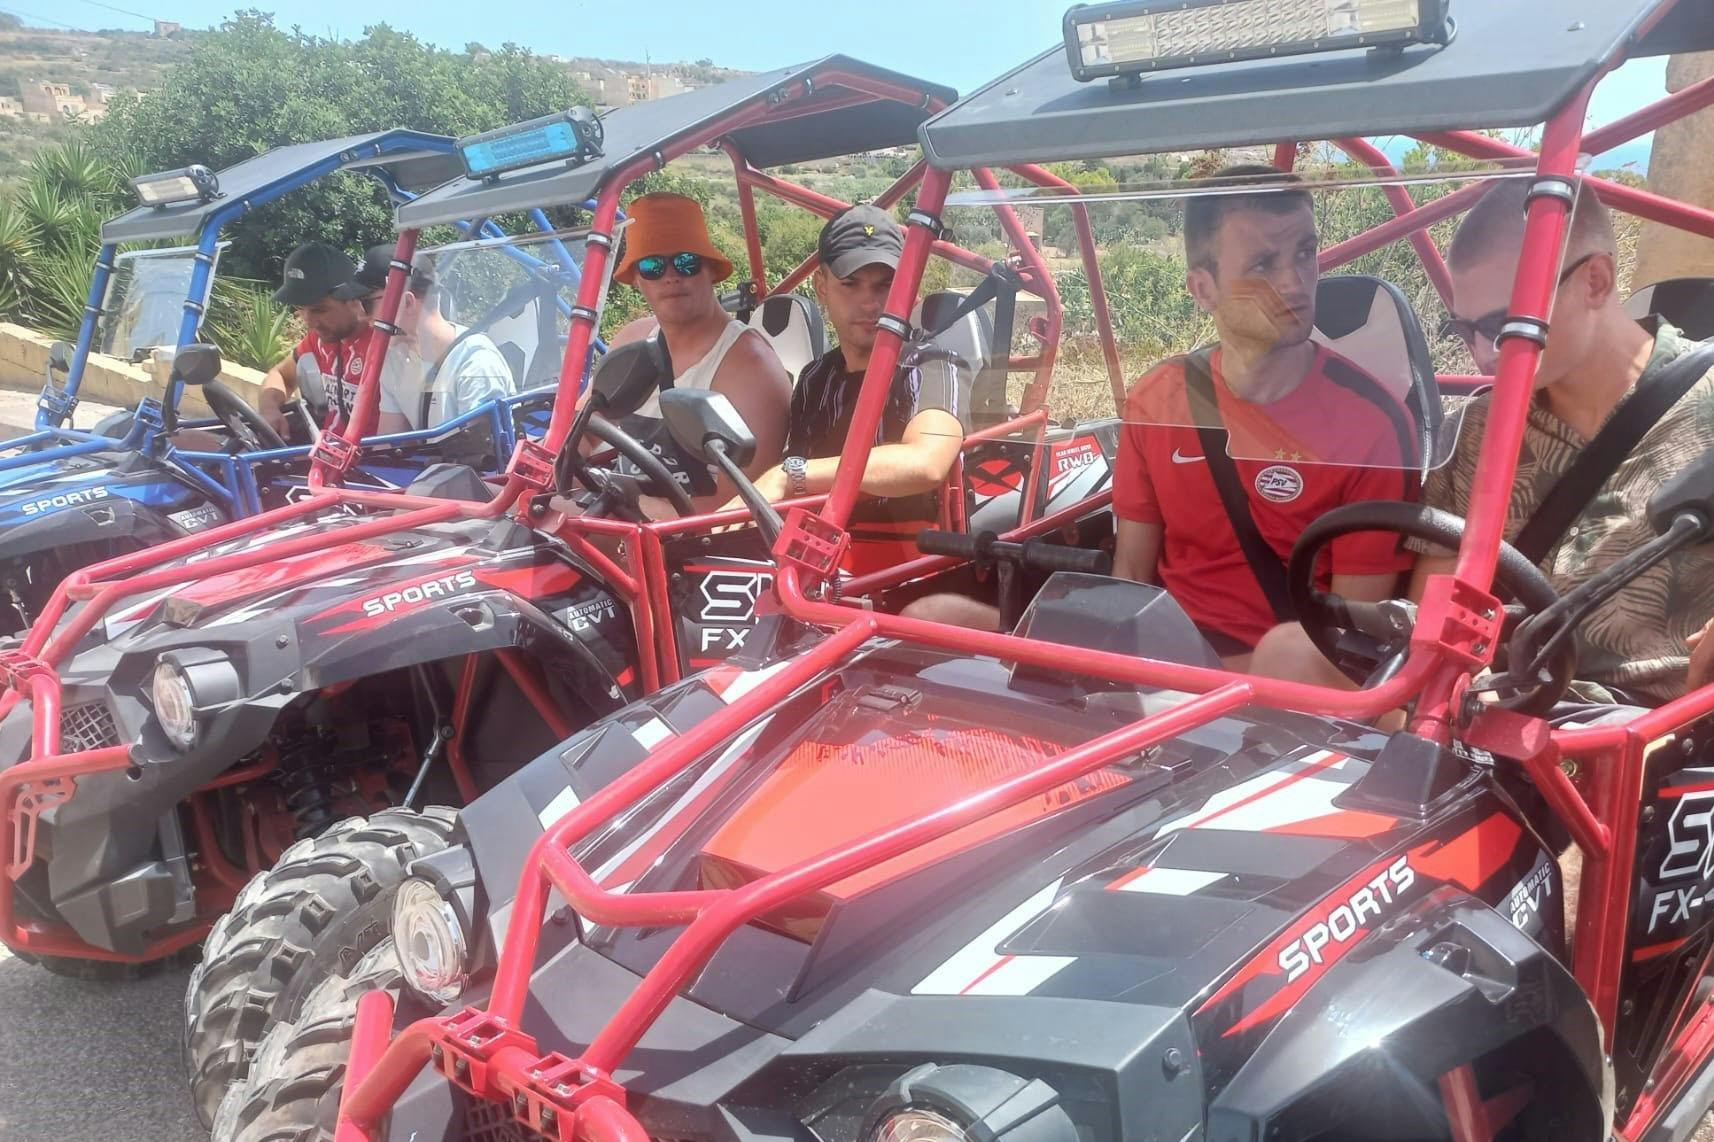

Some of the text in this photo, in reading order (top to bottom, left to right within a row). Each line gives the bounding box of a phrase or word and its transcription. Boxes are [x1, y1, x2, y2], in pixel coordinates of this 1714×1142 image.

[1058, 451, 1094, 472] RWD
[1270, 477, 1288, 487] PSV
[22, 486, 109, 515] SPORTS
[184, 512, 219, 529] CVT
[362, 571, 477, 617] SPORTS
[569, 599, 613, 619] AUTOMATIC
[571, 605, 616, 632] CVT
[1509, 861, 1551, 914] AUTOMATIC
[1512, 872, 1552, 929] CVT
[1278, 855, 1415, 983] SPORTS
